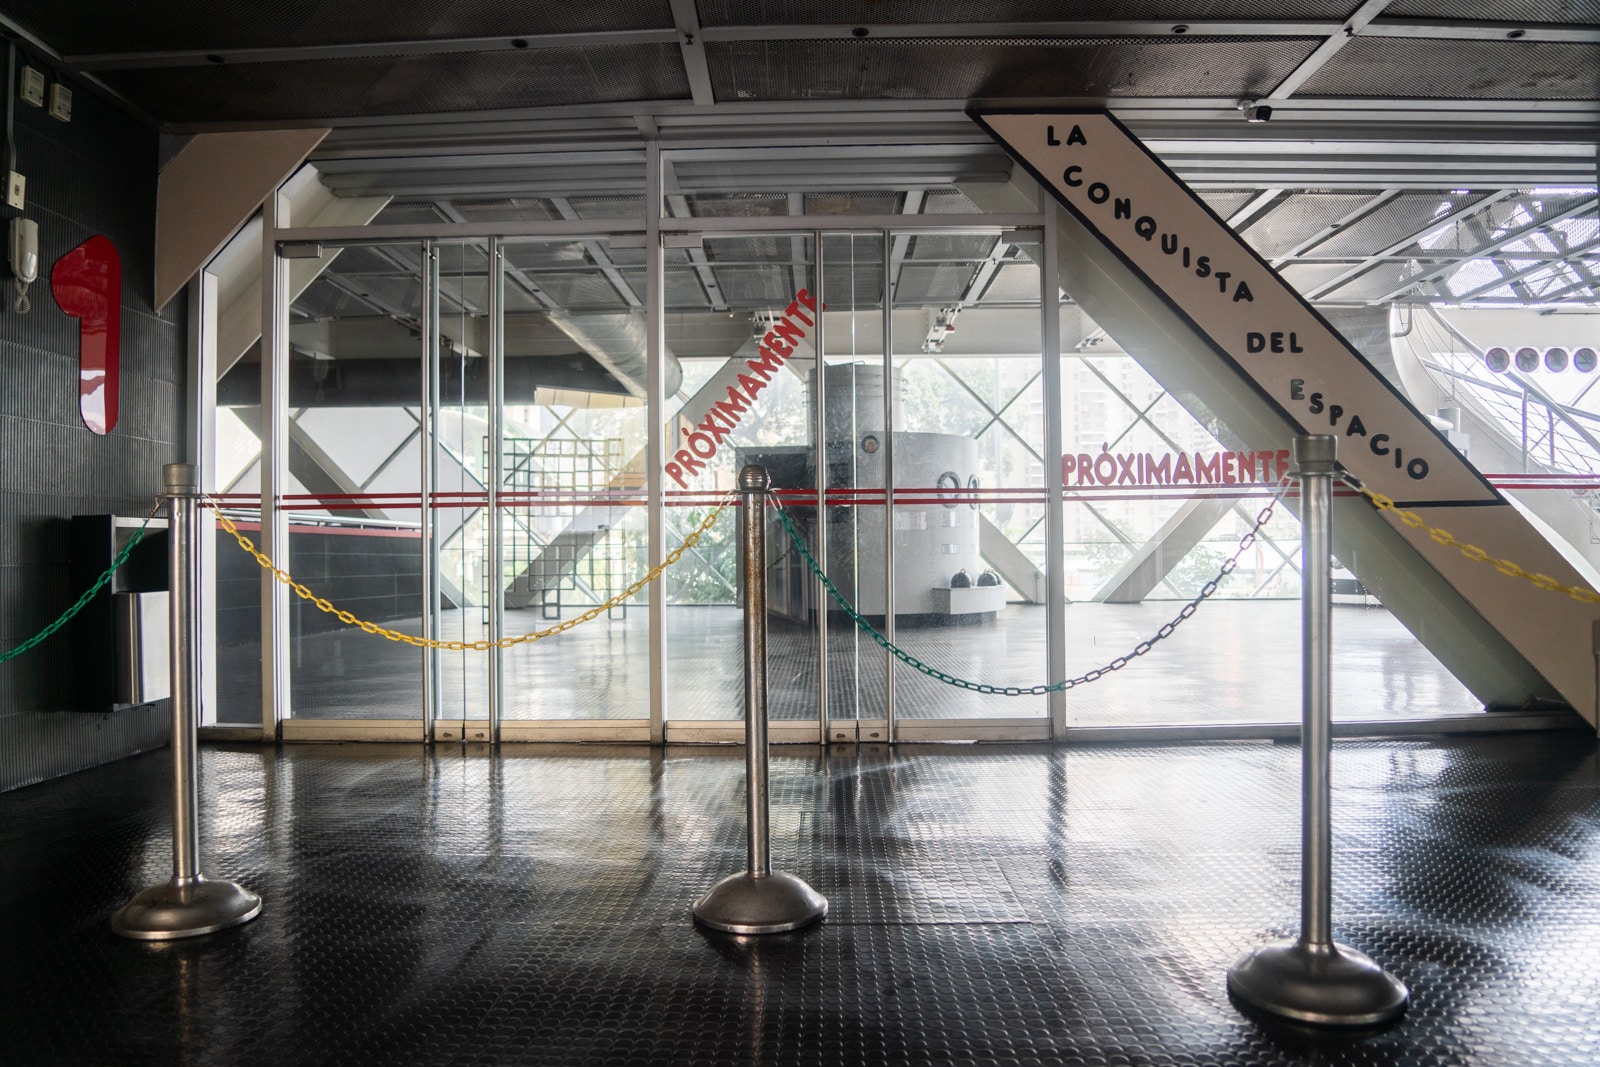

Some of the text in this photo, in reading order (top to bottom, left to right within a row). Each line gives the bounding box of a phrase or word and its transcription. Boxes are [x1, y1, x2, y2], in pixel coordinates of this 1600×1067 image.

[1047, 125, 1087, 147] LA
[1063, 166, 1254, 303] CONQUISTA
[1247, 332, 1304, 354] DEL
[1290, 379, 1430, 481] ESPACIO
